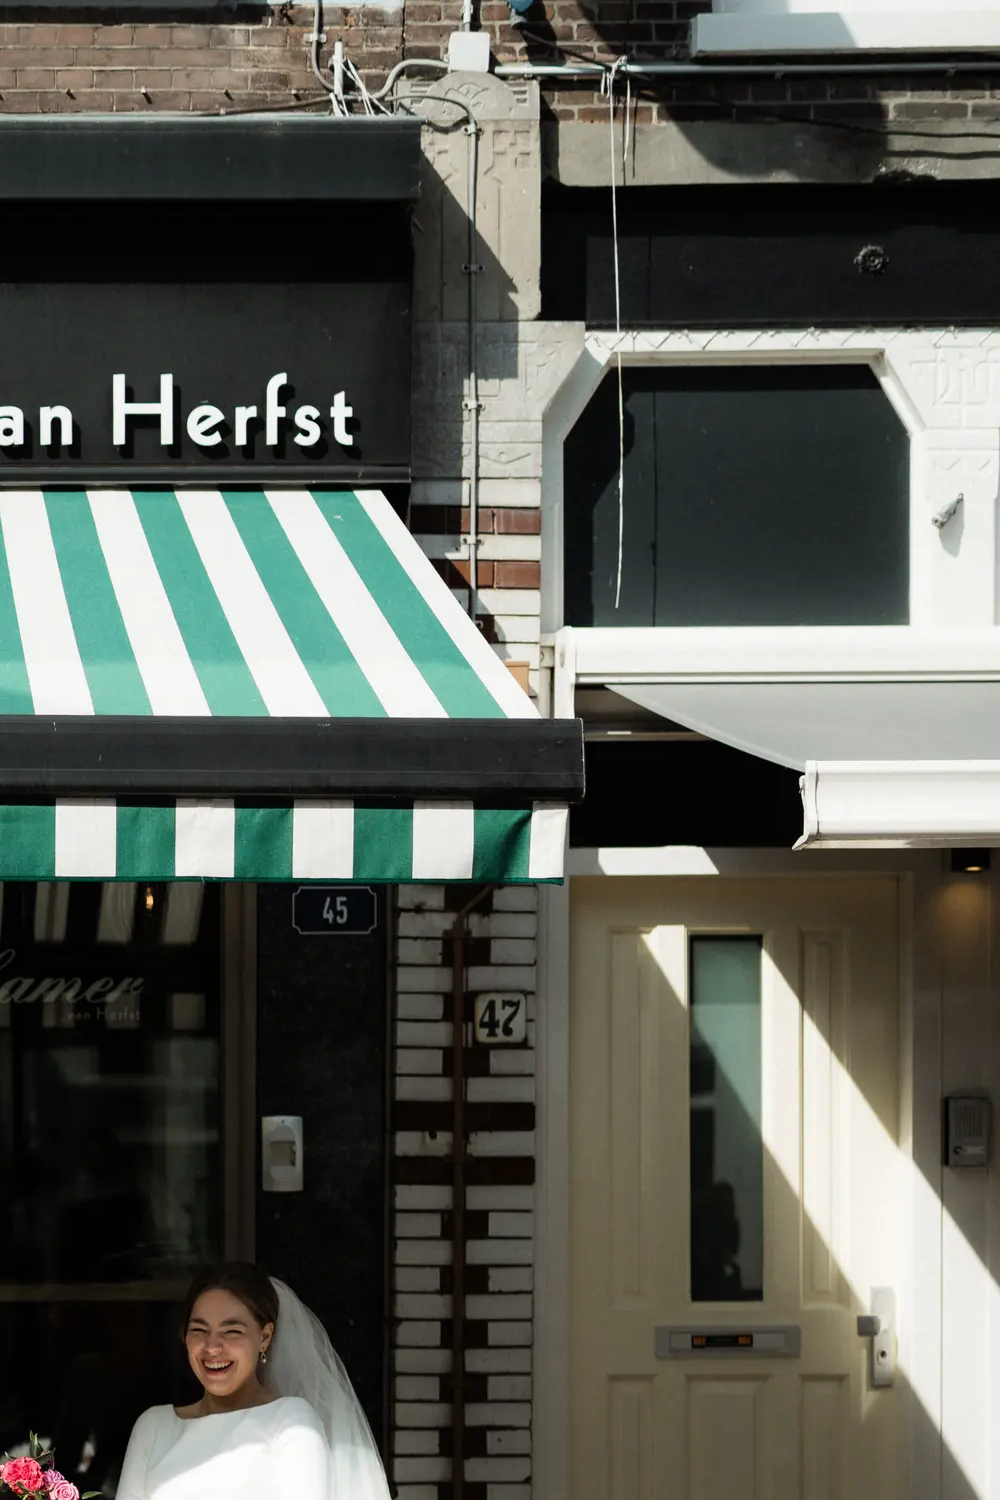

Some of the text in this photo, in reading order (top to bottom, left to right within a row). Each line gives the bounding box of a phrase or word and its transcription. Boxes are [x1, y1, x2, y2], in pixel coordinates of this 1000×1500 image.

[112, 372, 353, 446] Herfst
[322, 896, 348, 924] 45
[96, 1006, 141, 1021] Herfst
[478, 999, 521, 1038] 47
